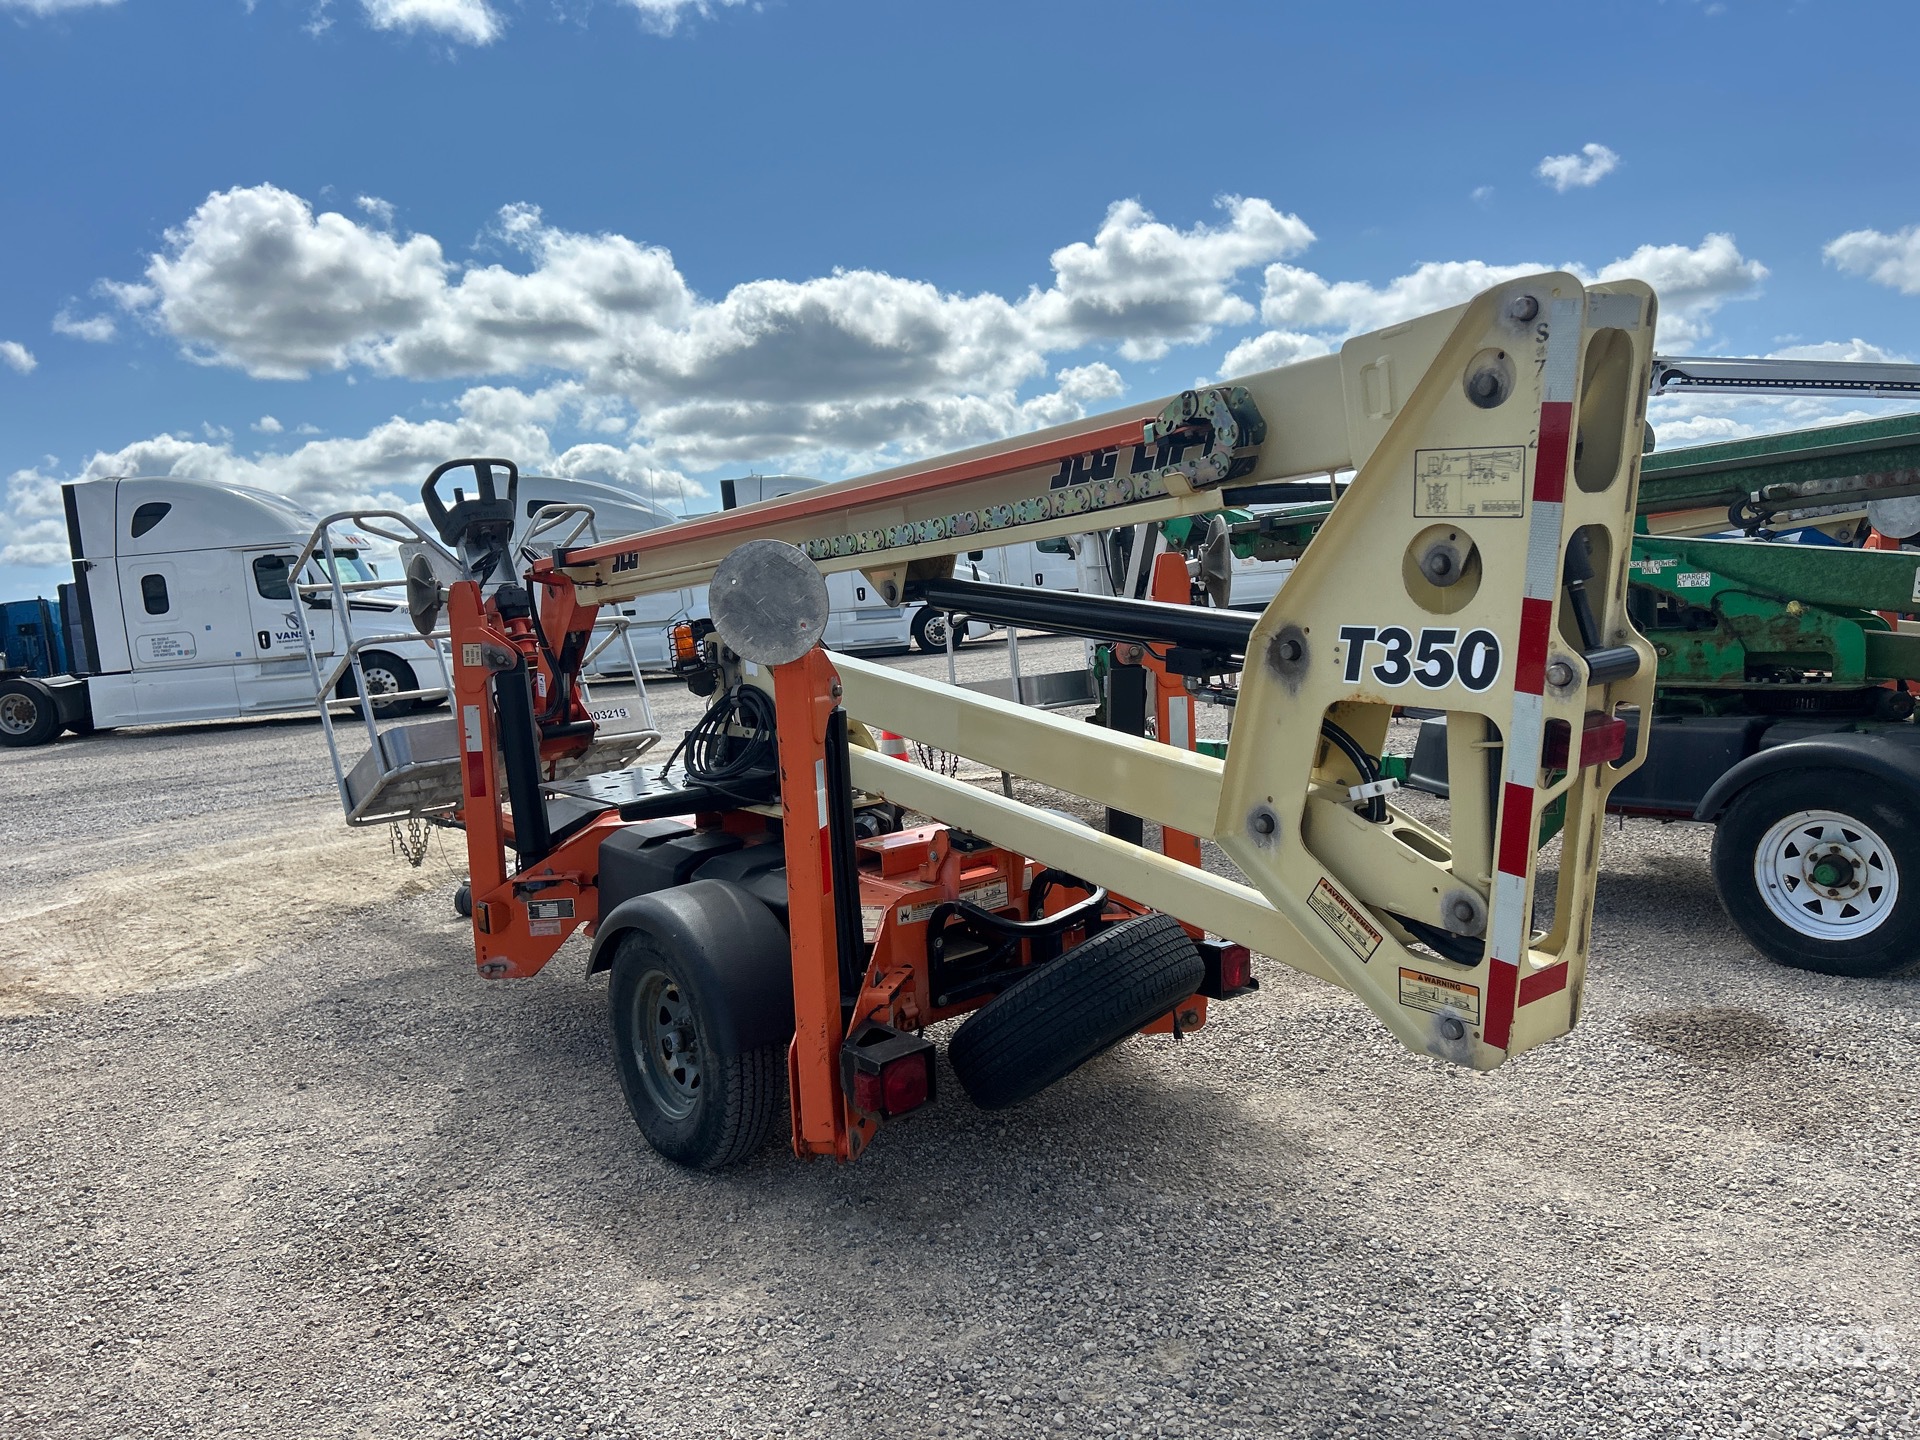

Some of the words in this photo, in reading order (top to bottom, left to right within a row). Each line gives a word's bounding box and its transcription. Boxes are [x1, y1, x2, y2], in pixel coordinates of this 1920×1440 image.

[1050, 444, 1121, 491] JLG
[611, 552, 639, 574] JLG
[1677, 573, 1710, 581] CHARGER
[400, 606, 411, 614] 90
[1338, 625, 1502, 693] T350
[1327, 887, 1379, 939] AVERTISSEMENT
[1424, 975, 1462, 991] WARNING
